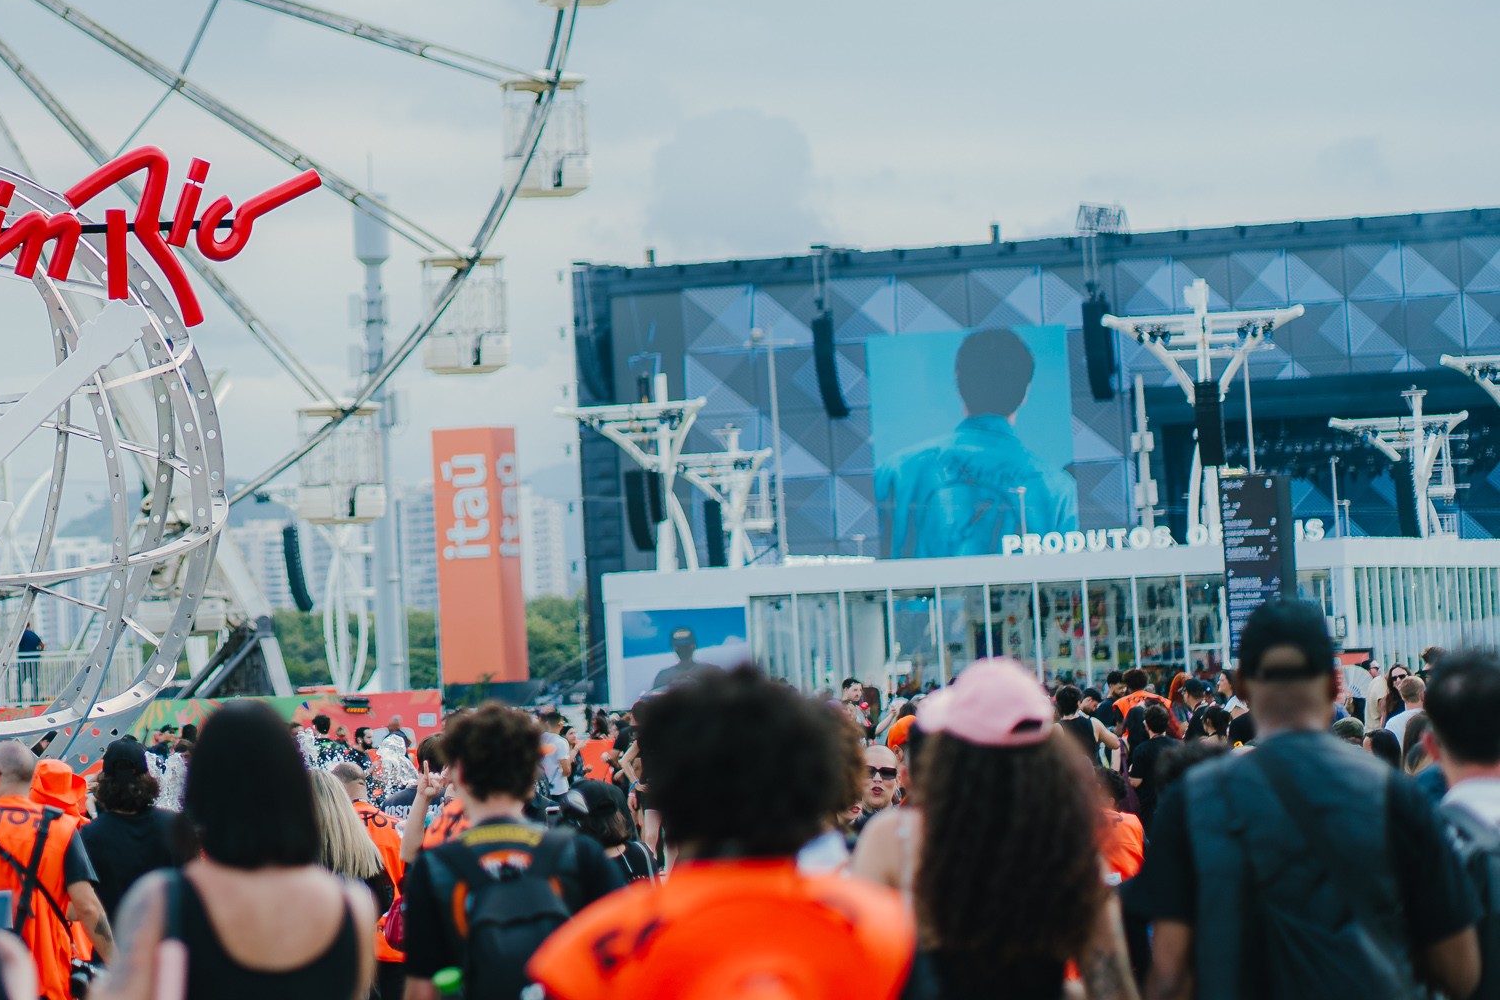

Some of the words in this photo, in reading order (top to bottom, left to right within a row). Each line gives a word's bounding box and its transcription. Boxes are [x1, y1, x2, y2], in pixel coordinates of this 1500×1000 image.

[64, 145, 322, 327] Rio
[440, 453, 490, 560] itaú
[1002, 525, 1172, 557] PRODUTOS
